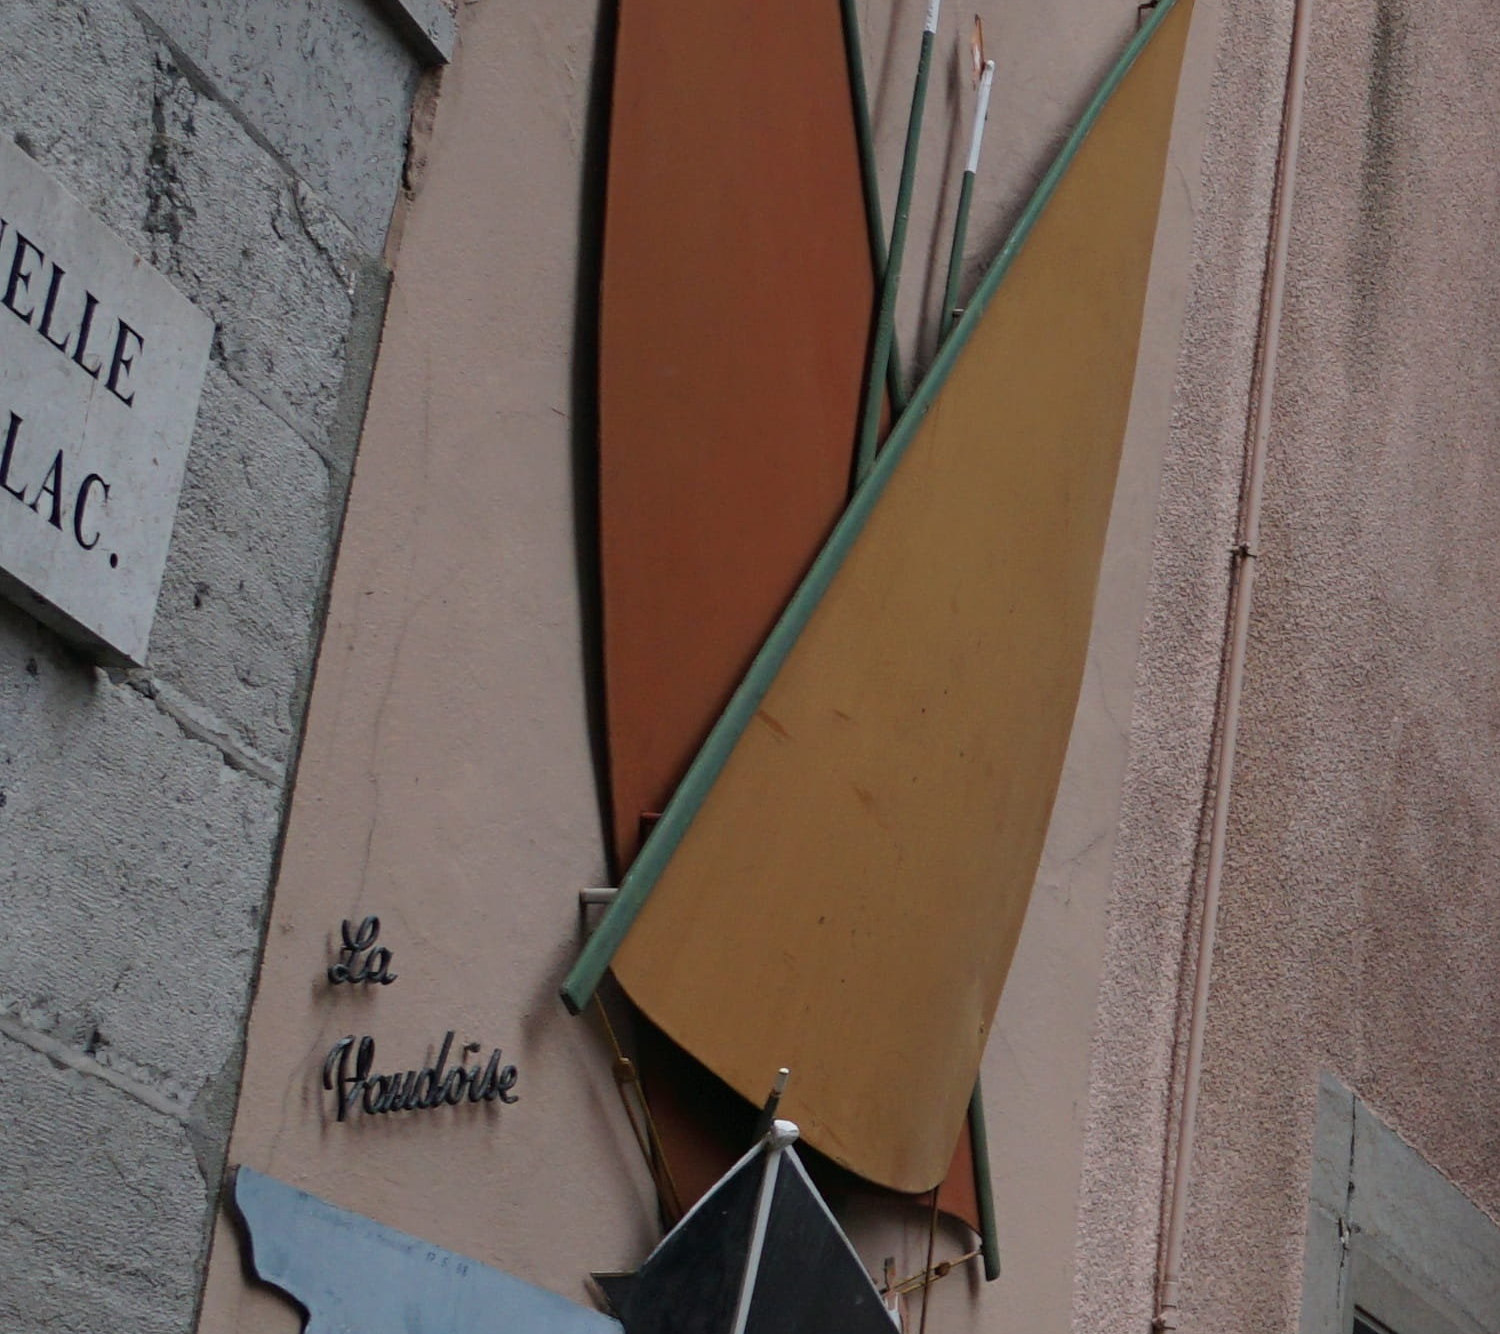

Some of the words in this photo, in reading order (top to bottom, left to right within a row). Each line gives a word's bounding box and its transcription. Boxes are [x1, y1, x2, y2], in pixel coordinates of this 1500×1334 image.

[0, 218, 145, 409] ELLE
[0, 410, 118, 569] LAC.
[327, 915, 398, 985] La
[323, 1031, 519, 1123] Vaudoise
